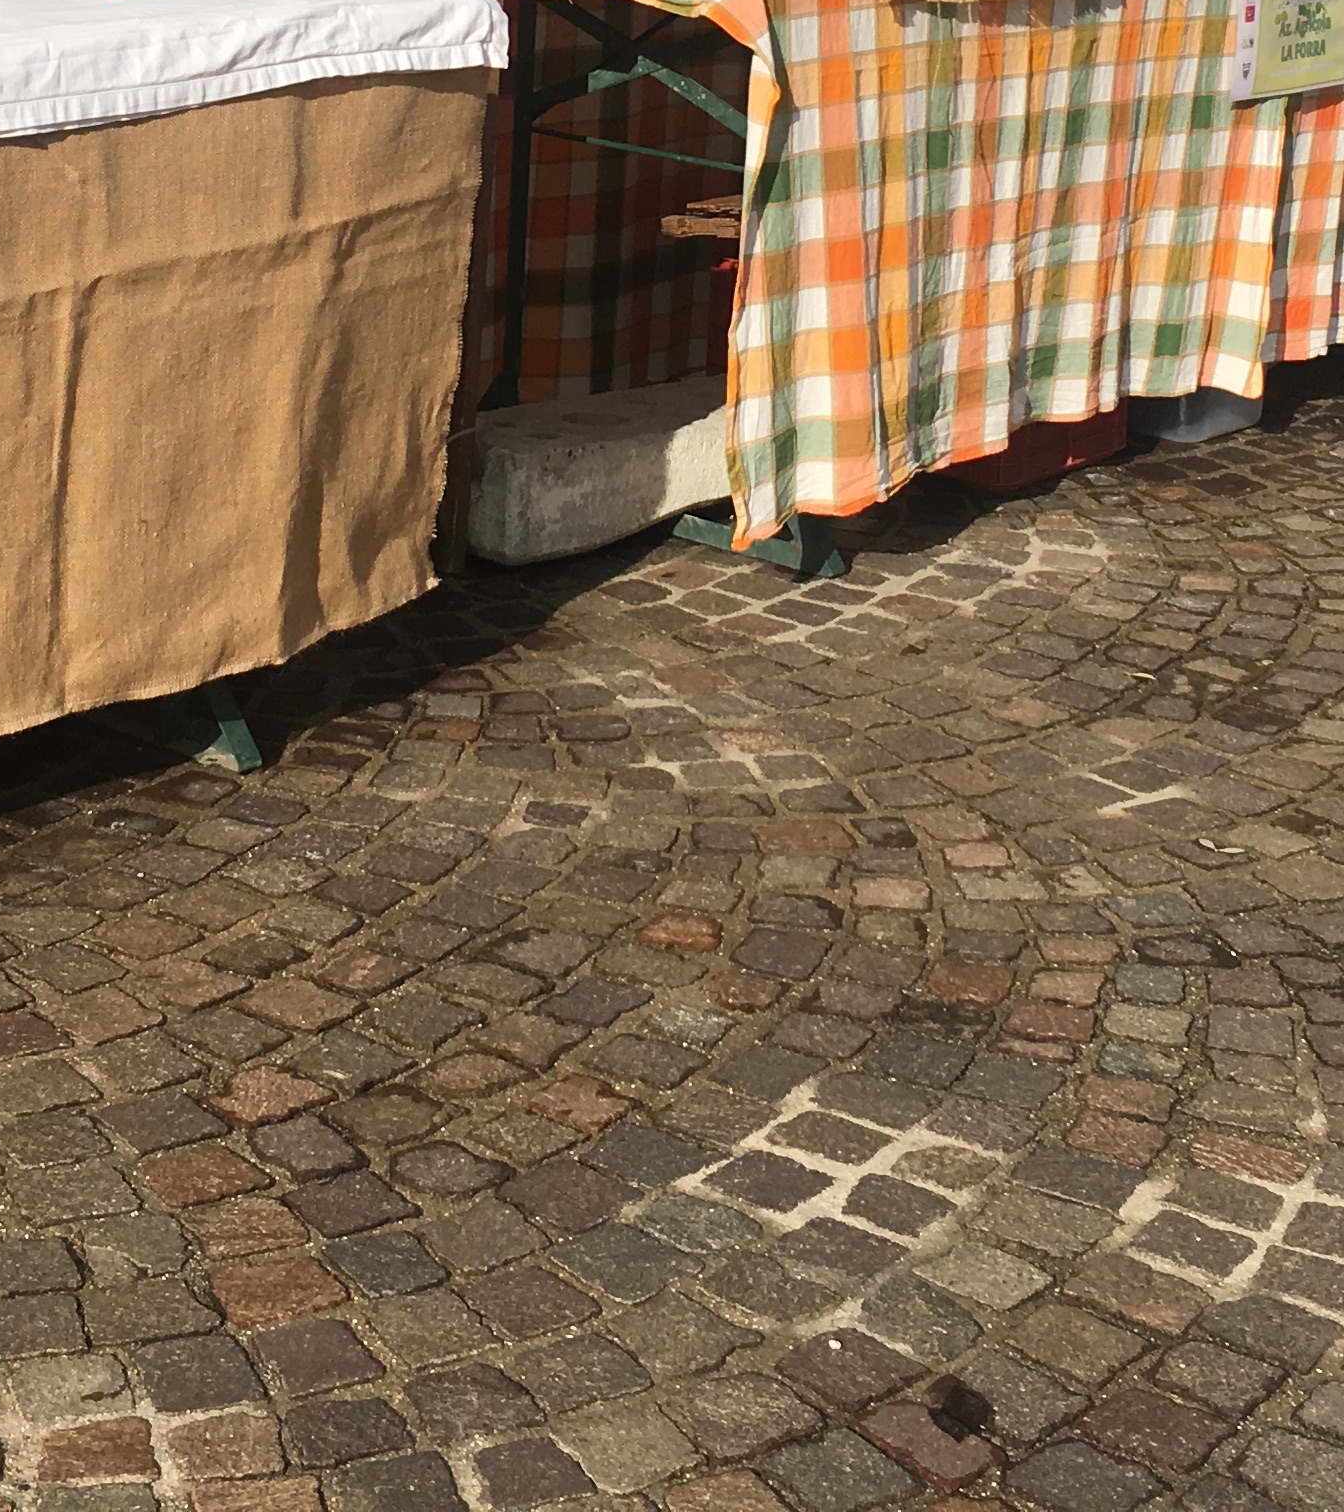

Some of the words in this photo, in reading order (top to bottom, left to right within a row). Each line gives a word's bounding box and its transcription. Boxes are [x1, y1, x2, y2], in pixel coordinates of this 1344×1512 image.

[1293, 16, 1332, 39] Agricola
[1280, 45, 1293, 62] LA
[1294, 39, 1326, 60] FORRA
